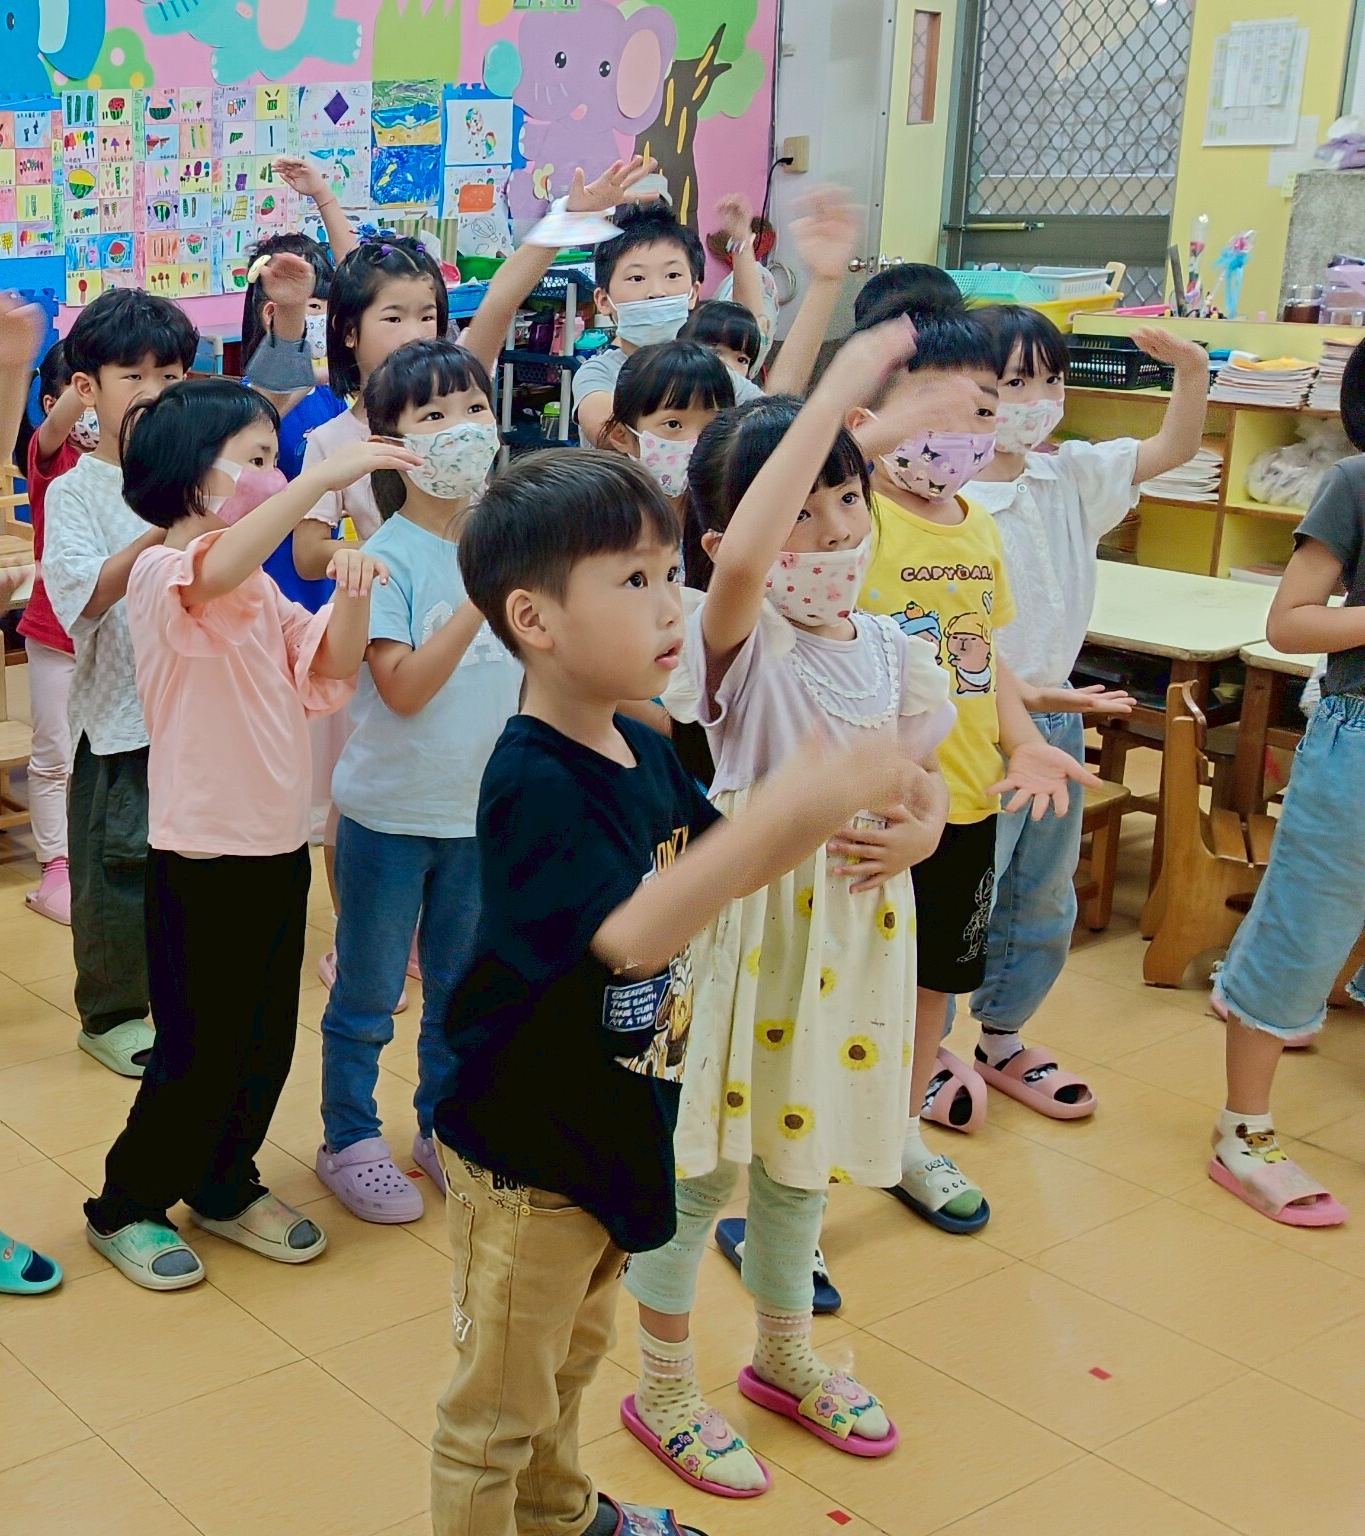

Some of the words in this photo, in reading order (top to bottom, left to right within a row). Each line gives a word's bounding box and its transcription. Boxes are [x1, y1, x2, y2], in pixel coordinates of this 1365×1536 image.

[611, 1000, 631, 1009] THE
[632, 992, 657, 1006] EARTH
[625, 1018, 633, 1026] A
